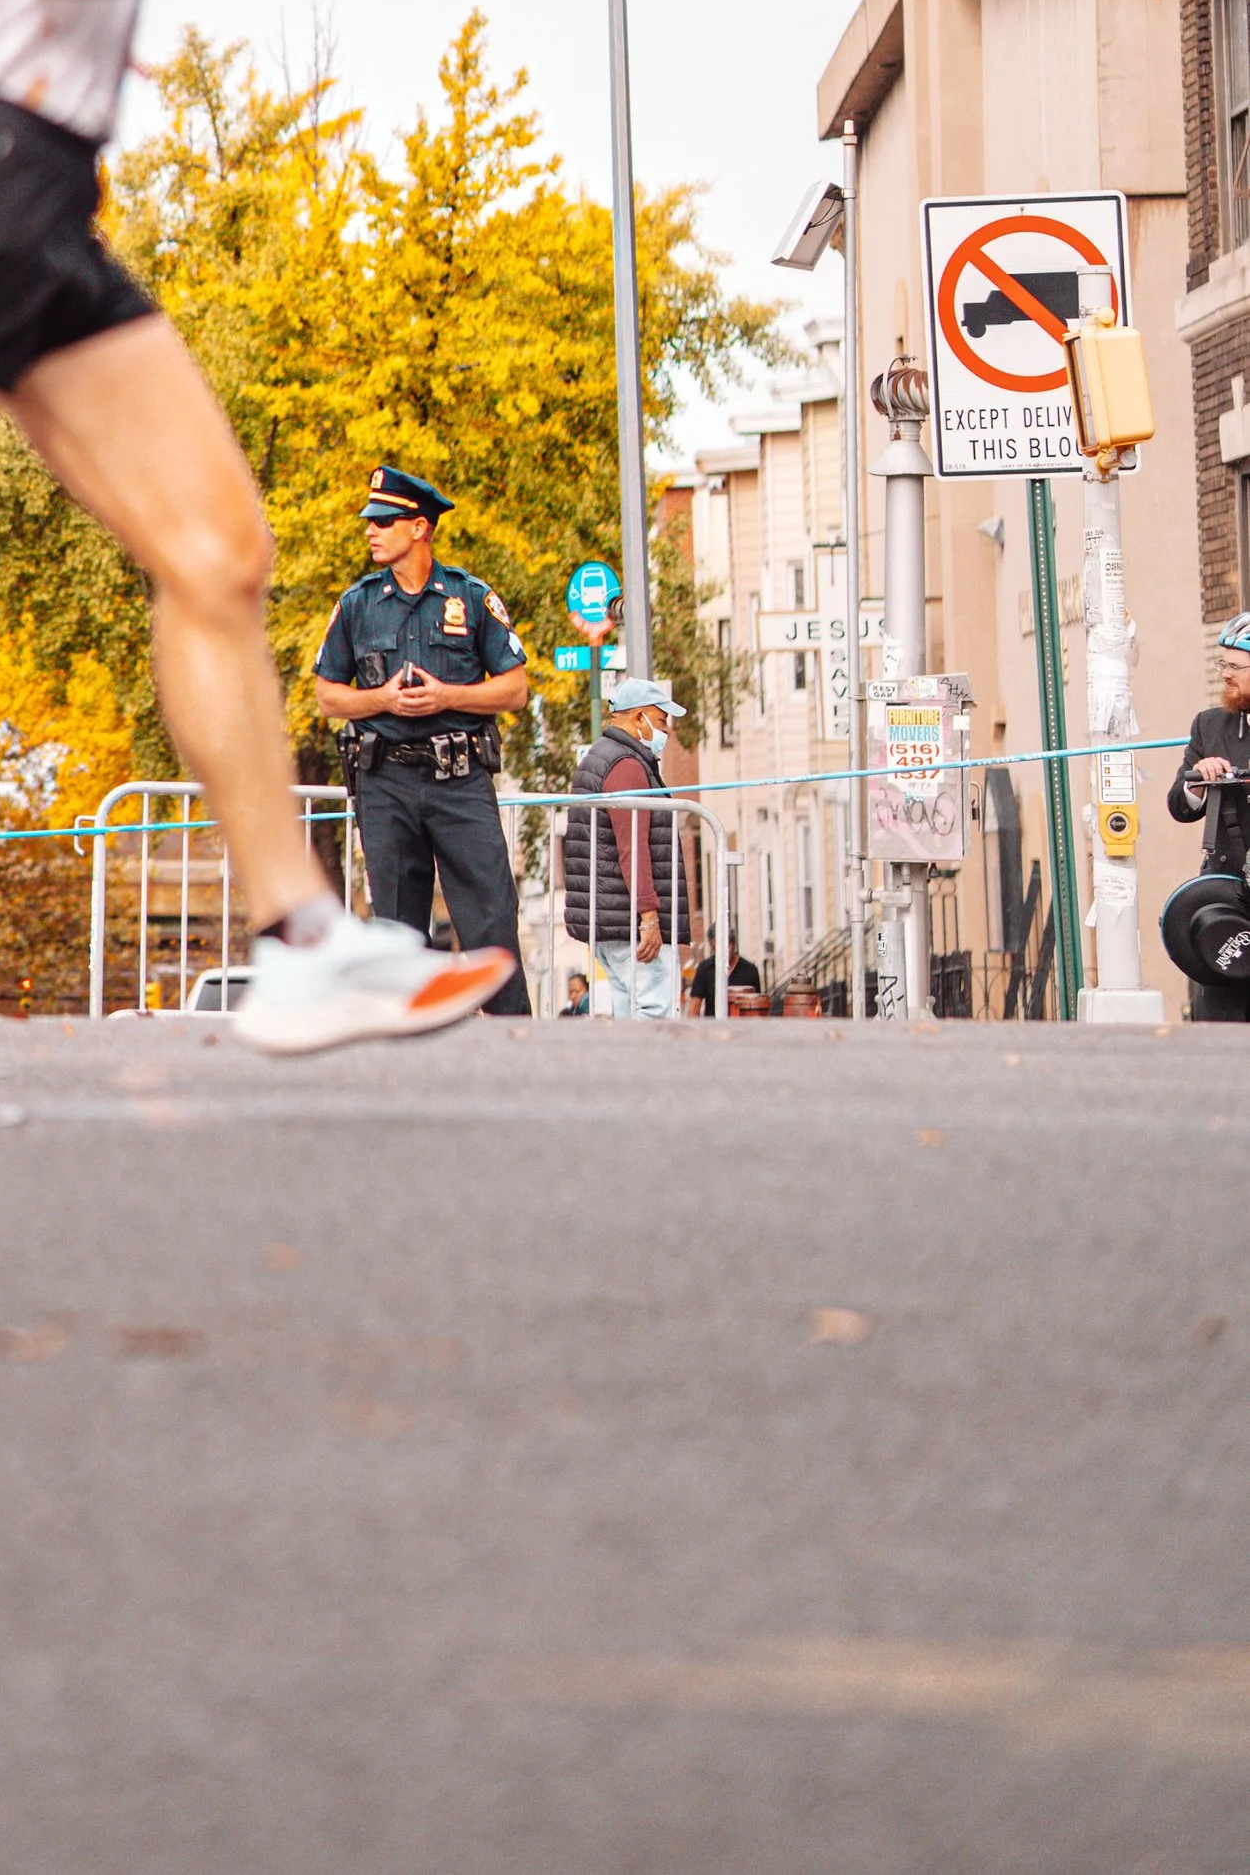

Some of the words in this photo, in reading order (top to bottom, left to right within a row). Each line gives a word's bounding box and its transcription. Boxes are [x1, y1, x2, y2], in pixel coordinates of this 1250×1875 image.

[944, 408, 1009, 431] EXCEPT
[969, 438, 1017, 460] THIS
[888, 709, 941, 726] FURNITURE
[889, 726, 940, 742] MOVERS
[889, 743, 941, 757] (516)
[895, 756, 934, 767] 491
